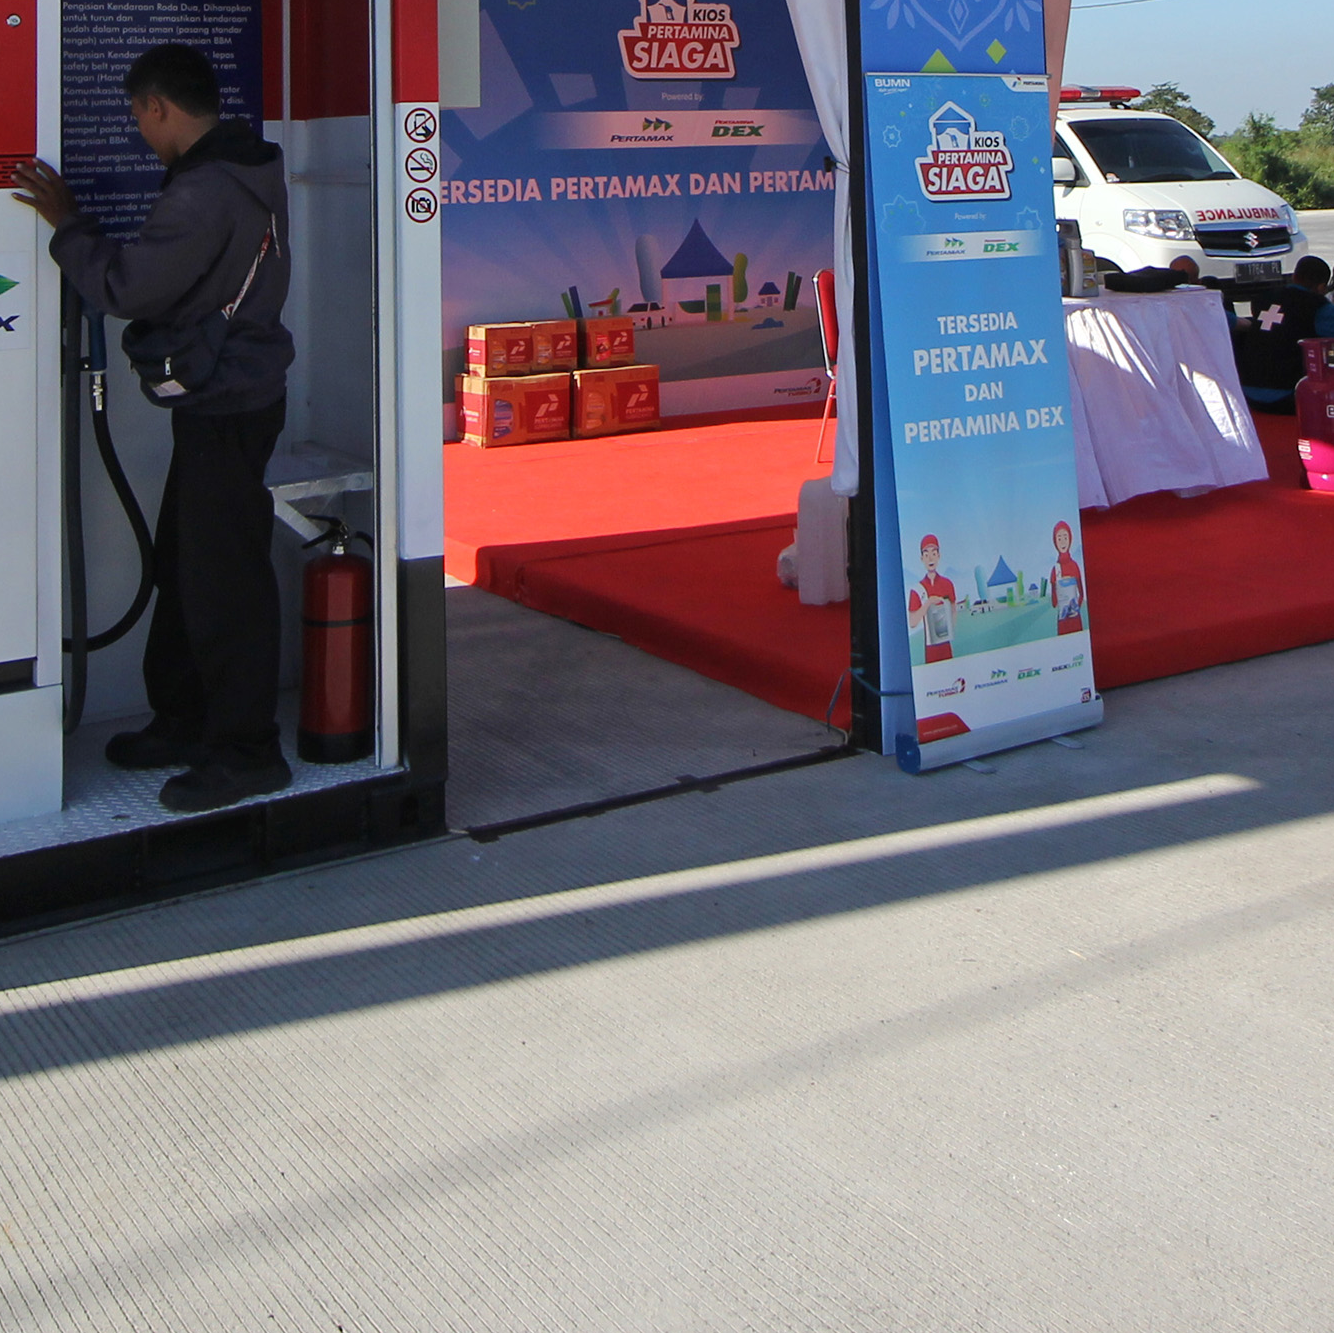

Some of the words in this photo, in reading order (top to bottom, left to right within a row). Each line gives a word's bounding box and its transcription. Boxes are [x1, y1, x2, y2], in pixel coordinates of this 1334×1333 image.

[63, 2, 105, 11] Pengisian
[107, 3, 154, 11] Kendaraan
[157, 3, 178, 11] Roda
[204, 4, 251, 12] Diharapkan
[117, 14, 133, 22] dan
[693, 9, 725, 21] KIOS
[648, 25, 729, 39] PERTAMINA
[63, 51, 105, 60] Pengisian
[213, 52, 234, 60] lepas
[632, 42, 726, 68] SIAGA
[63, 62, 89, 71] safety
[63, 74, 95, 83] tangan
[98, 74, 124, 82] (Hand
[875, 79, 910, 88] BUMN
[64, 87, 126, 95] Komunikasika
[64, 99, 88, 107] untuk
[91, 99, 121, 107] jumlah
[64, 115, 100, 123] Pastikan
[103, 114, 130, 122] ujung
[64, 126, 96, 134] nempel
[712, 125, 764, 137] DEX
[975, 137, 999, 147] KIOS
[938, 152, 1003, 164] PERTAMINA
[135, 163, 168, 171] letakka
[928, 166, 1001, 191] SIAGA
[440, 178, 541, 205] ERSEDIA
[551, 174, 681, 200] PERTAMAX
[689, 172, 741, 195] DAN
[749, 169, 834, 192] PERTAM
[94, 192, 141, 201] kendaraan
[116, 203, 137, 211] anda
[983, 242, 1019, 252] DEX
[937, 312, 1018, 334] TERSEDIA
[914, 339, 1048, 375] PERTAMAX
[965, 381, 1003, 402] DAN
[905, 411, 1019, 444] PERTAMINA
[1026, 406, 1064, 429] DEX
